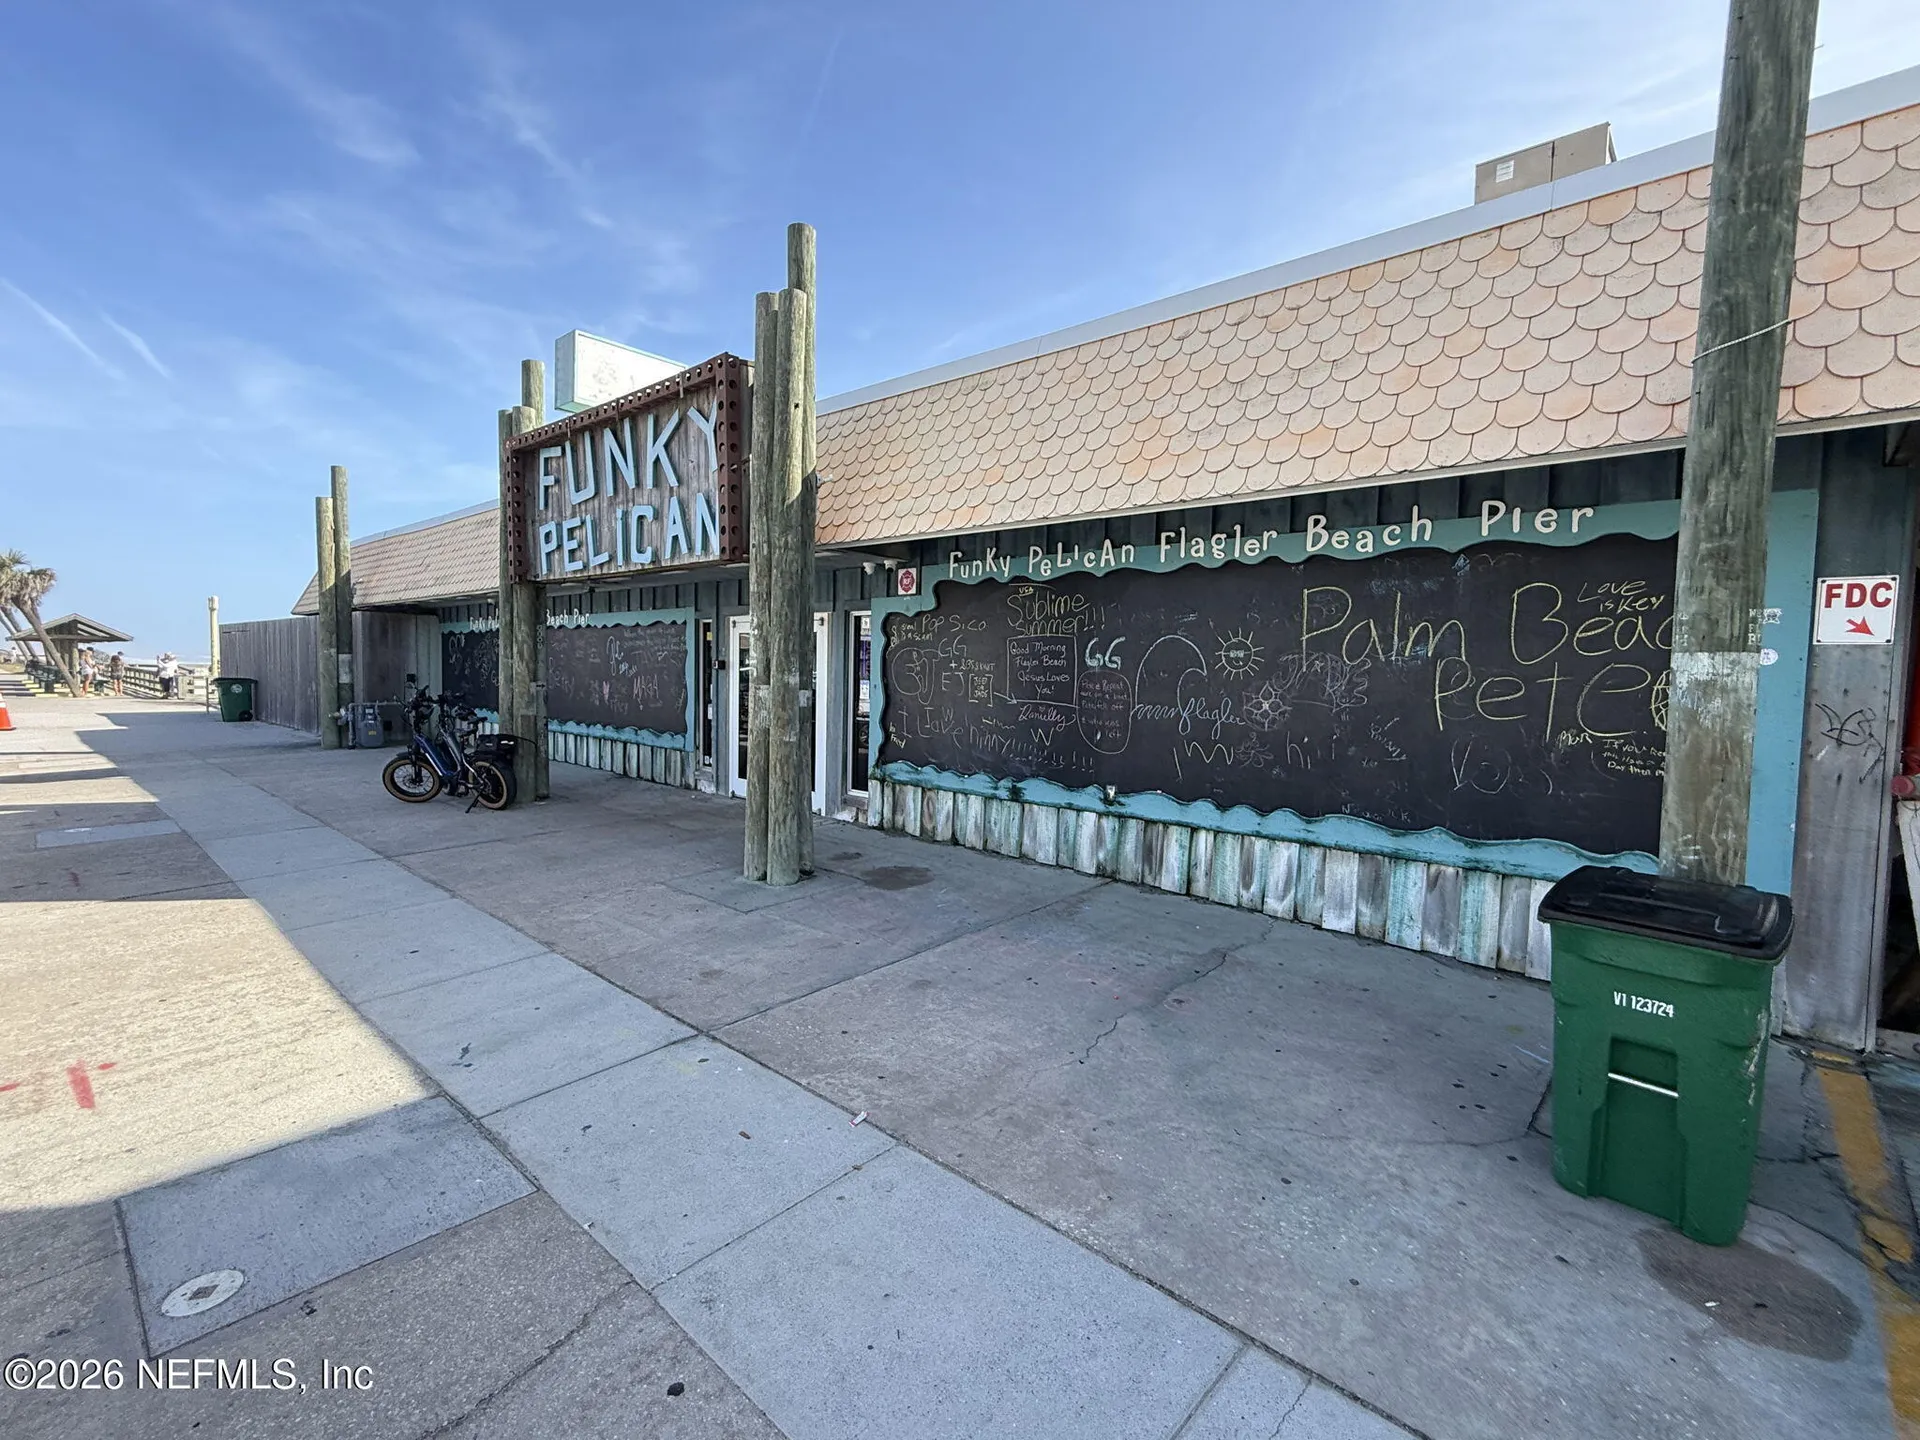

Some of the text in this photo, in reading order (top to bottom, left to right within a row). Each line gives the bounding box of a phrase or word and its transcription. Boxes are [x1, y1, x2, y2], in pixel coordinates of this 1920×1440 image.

[538, 399, 718, 511] FUNKY
[538, 493, 720, 576] PELICAN
[1159, 524, 1278, 562] Flagler
[1306, 504, 1433, 553] Beach
[1482, 500, 1595, 537] Pier
[1577, 579, 1648, 602] Love
[1823, 581, 1893, 609] FDC
[1007, 590, 1092, 627] Sublime
[1298, 584, 1466, 673] Palm
[1511, 582, 1674, 666] Beac
[1010, 641, 1067, 658] Good Morning
[1017, 670, 1071, 687] Jesus Loves
[1630, 995, 1674, 1018] 123724
